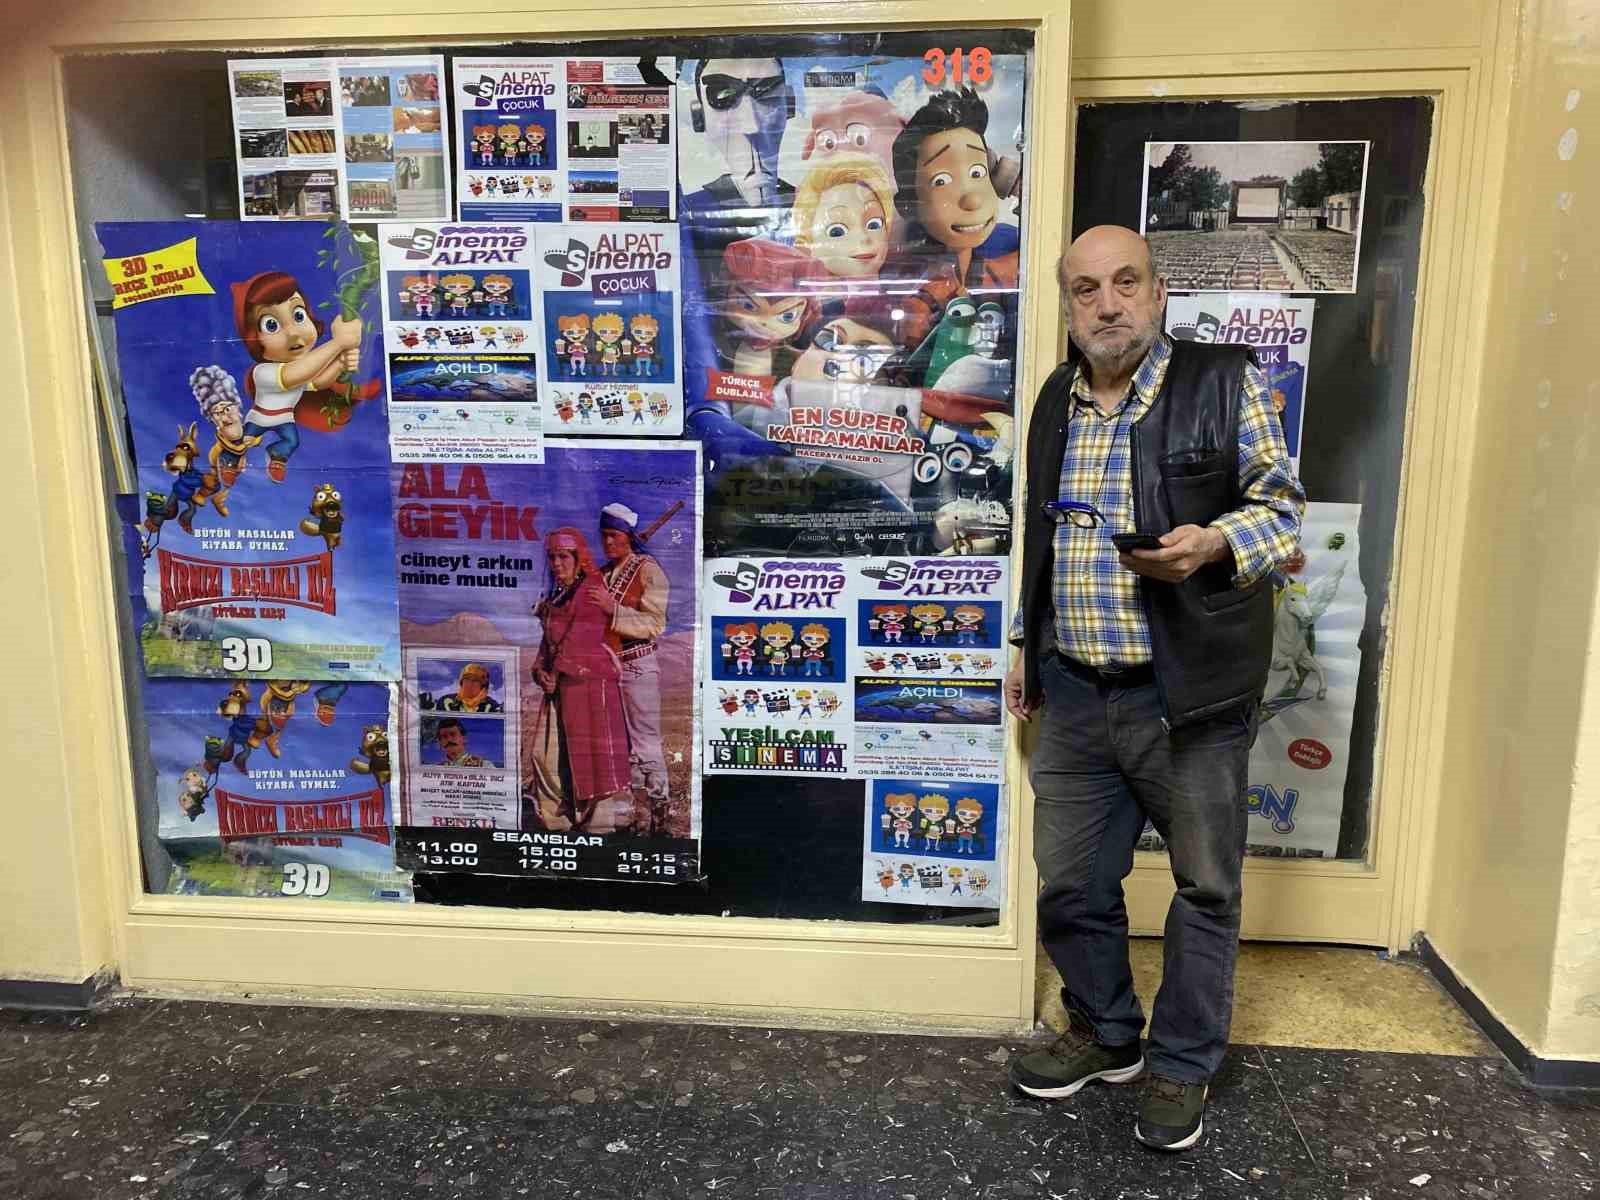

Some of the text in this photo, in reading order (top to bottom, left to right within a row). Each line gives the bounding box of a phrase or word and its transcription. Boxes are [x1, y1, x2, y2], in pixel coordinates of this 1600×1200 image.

[922, 47, 993, 83] 318
[501, 72, 549, 84] ALPAT
[478, 82, 556, 97] Sinema
[503, 100, 540, 113] ÇOCUK
[412, 234, 527, 250] Sinema
[596, 234, 664, 252] ALPAT
[432, 248, 524, 266] ALPAT
[566, 249, 672, 272] Sinema
[600, 276, 649, 294] ÇOCUK
[1229, 309, 1301, 327] ALPAT
[1193, 322, 1307, 345] Sinema
[1255, 351, 1281, 363] UK
[435, 363, 498, 376] AÇILDI
[721, 376, 760, 388] TÜRKÇE
[790, 407, 823, 426] EN
[768, 424, 925, 455] KAHRAMANLAR
[796, 449, 843, 460] MACERAYA
[845, 455, 872, 463] HAZIR
[398, 463, 491, 500] ALA
[398, 501, 541, 541] GEYİK
[238, 529, 295, 539] MASALLAR
[202, 540, 288, 551] KİTABA UYMAZ.
[400, 552, 533, 571] cüneyt arkın
[157, 551, 224, 614] KIRMIZI
[306, 551, 336, 616] KIZ
[401, 570, 518, 588] mine mutlu
[735, 570, 846, 590] Sinema
[885, 567, 1002, 583] Sinema
[904, 581, 997, 596] ALPAT
[753, 591, 841, 611] ALPAT
[222, 637, 272, 672] 3D
[900, 686, 962, 699] AÇILDI
[720, 744, 836, 764] SİNEMA
[289, 769, 345, 778] MASALLAR
[300, 780, 340, 789] UYMAZ.
[432, 815, 496, 829] RENKLİ
[493, 832, 603, 846] SEANSLAR
[417, 842, 676, 863] 11.00 15.00 19.15
[417, 854, 676, 876] 13.00 17.00 21.15
[281, 863, 330, 896] 3D
